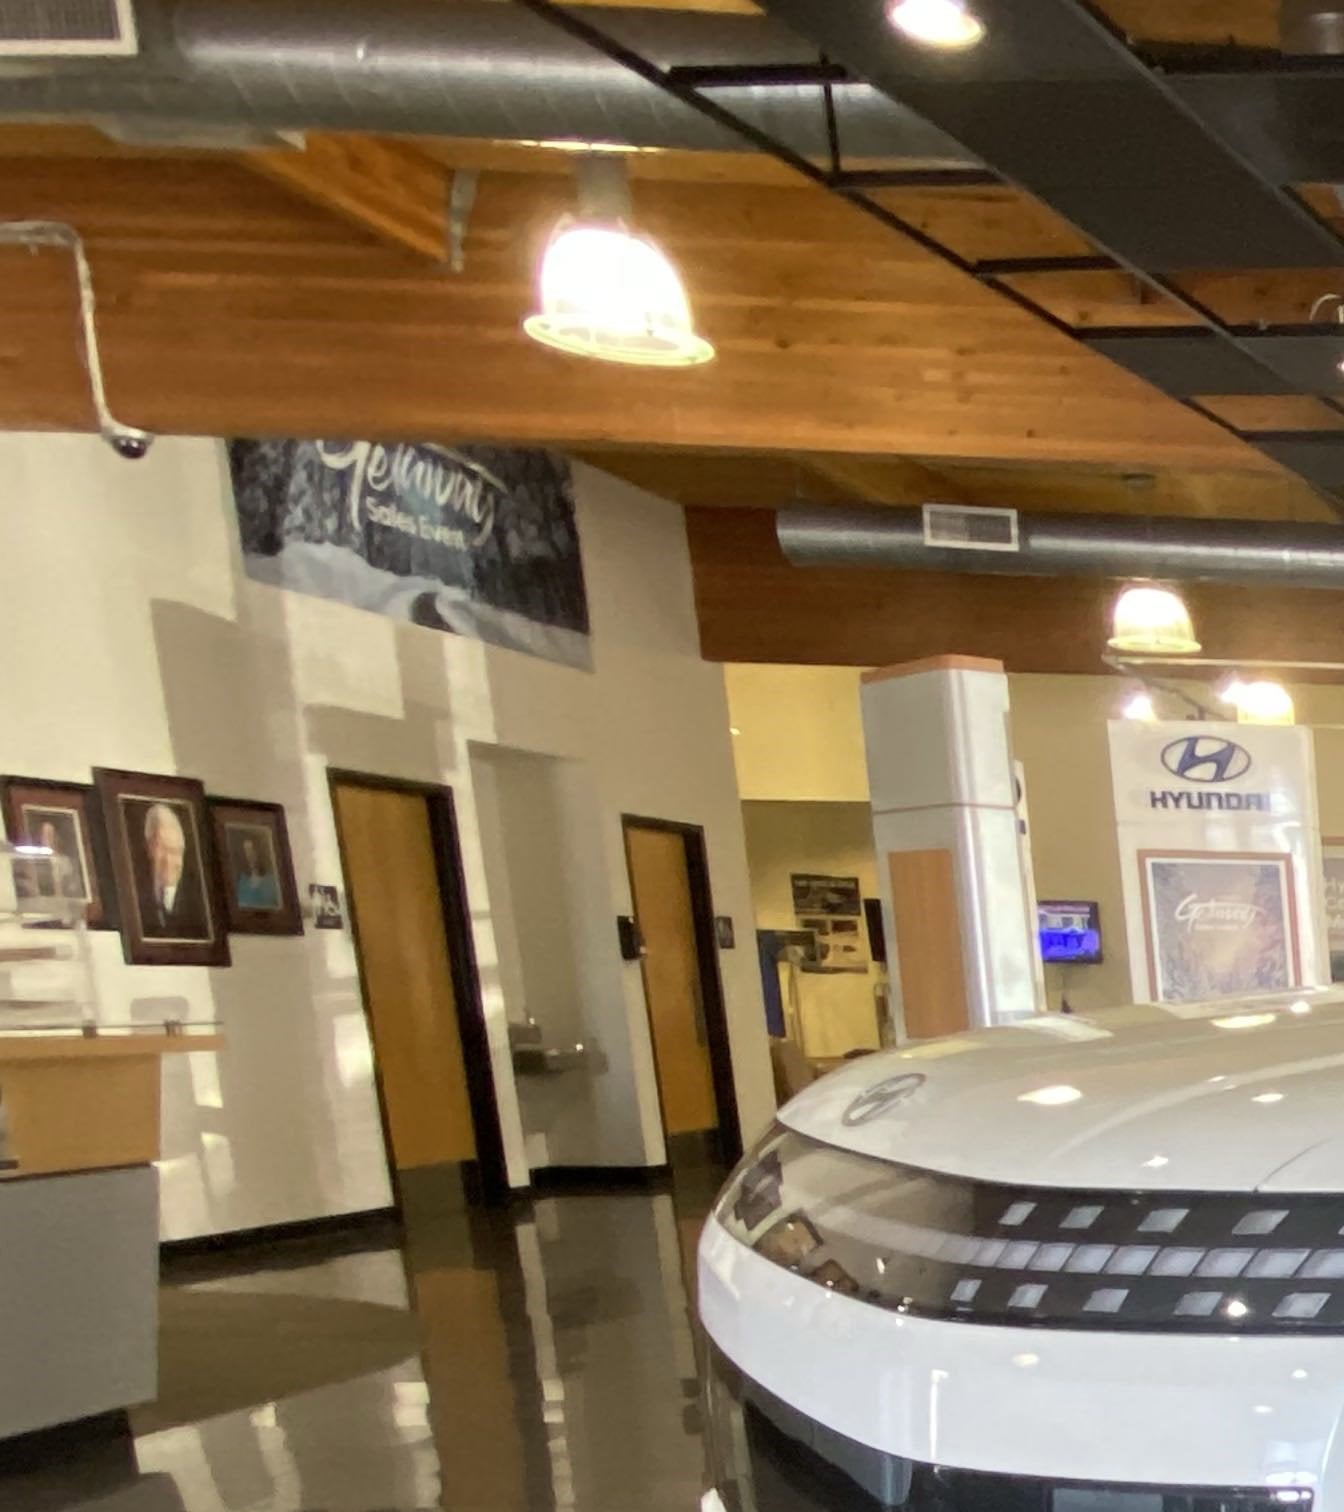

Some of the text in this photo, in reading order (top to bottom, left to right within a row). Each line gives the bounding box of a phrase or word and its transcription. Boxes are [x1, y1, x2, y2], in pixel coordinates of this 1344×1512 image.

[365, 496, 469, 550] Sales Event
[1150, 790, 1271, 812] HYUNDAI
